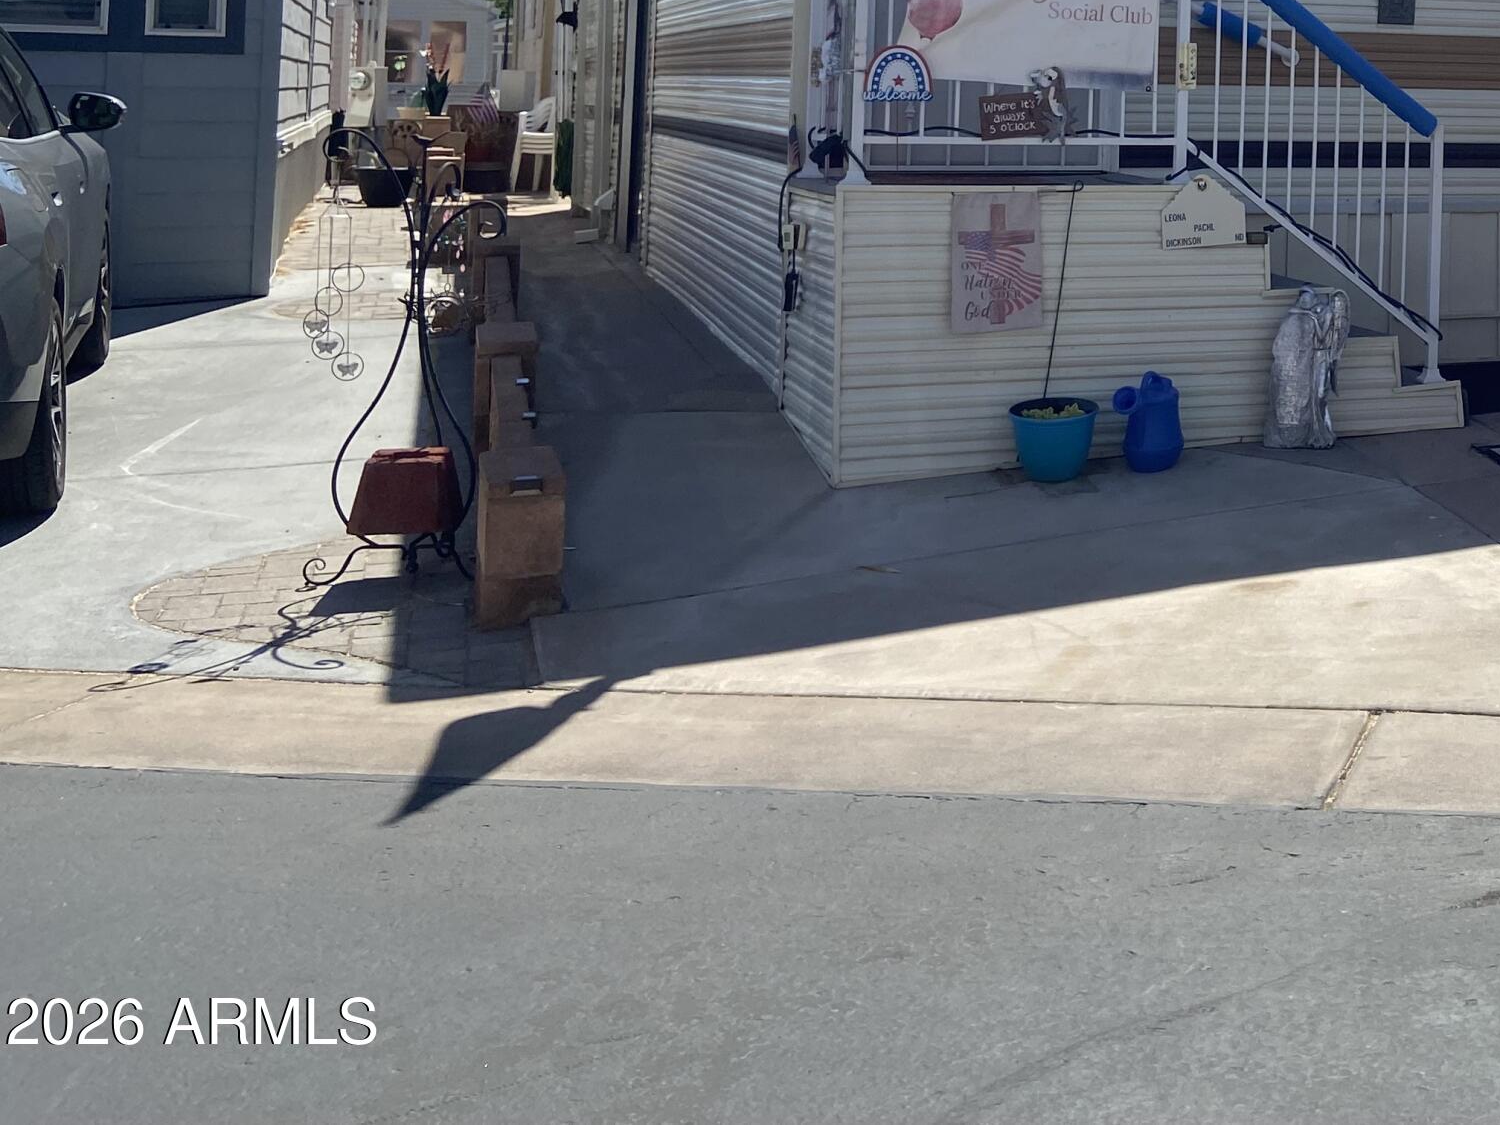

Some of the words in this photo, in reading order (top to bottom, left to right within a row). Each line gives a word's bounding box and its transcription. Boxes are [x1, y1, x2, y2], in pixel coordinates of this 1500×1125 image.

[1047, 2, 1104, 23] Social
[1110, 5, 1153, 25] Club
[863, 86, 934, 102] welcome
[983, 101, 1017, 114] Where
[993, 111, 1026, 124] always
[989, 125, 997, 134] 5
[1164, 213, 1187, 223] LEONA
[1165, 237, 1202, 248] DICKINSON
[1234, 233, 1244, 242] ND
[964, 299, 994, 321] God
